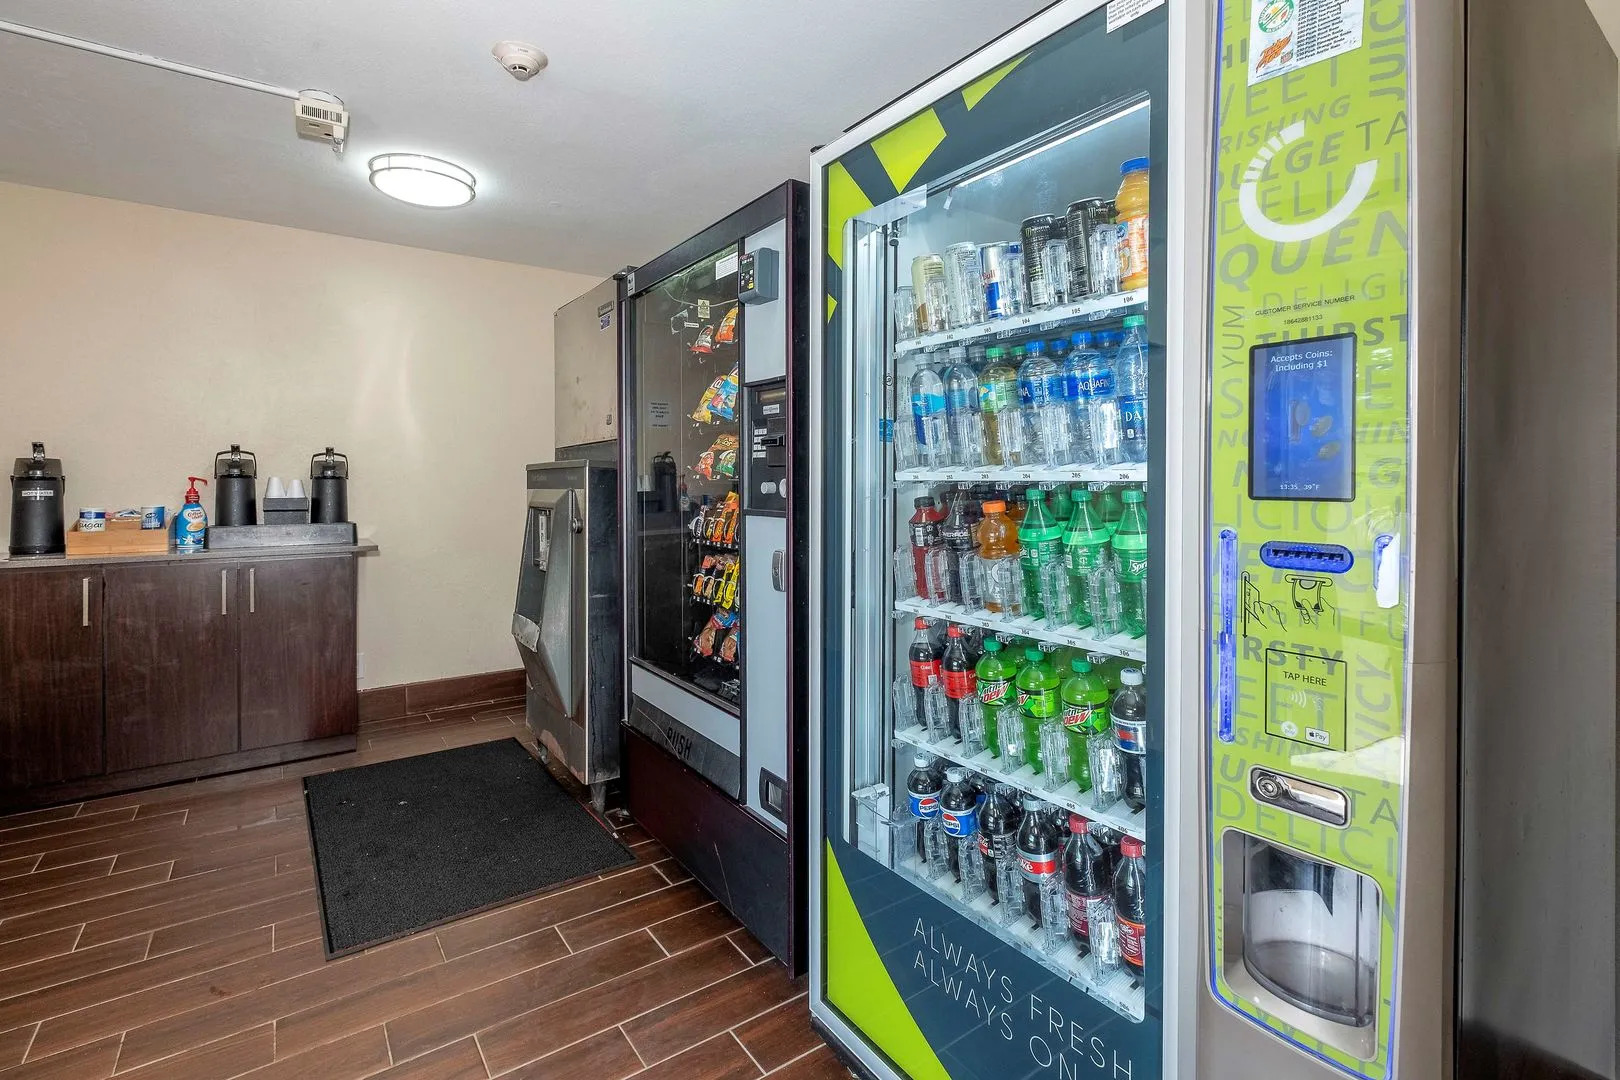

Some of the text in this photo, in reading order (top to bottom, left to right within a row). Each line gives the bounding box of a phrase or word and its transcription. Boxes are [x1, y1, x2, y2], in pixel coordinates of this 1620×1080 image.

[1255, 295, 1355, 316] CUSTOMER SERVICE NUMBER
[1270, 349, 1333, 364] Accepts Coins:
[1275, 360, 1328, 372] Including $1
[1283, 671, 1327, 686] TAP HERE
[665, 726, 693, 760] PUSH
[1117, 825, 1129, 834] 406
[913, 917, 1132, 1080] ALWAYS FRESH
[913, 950, 1077, 1080] ALWAYS ON
